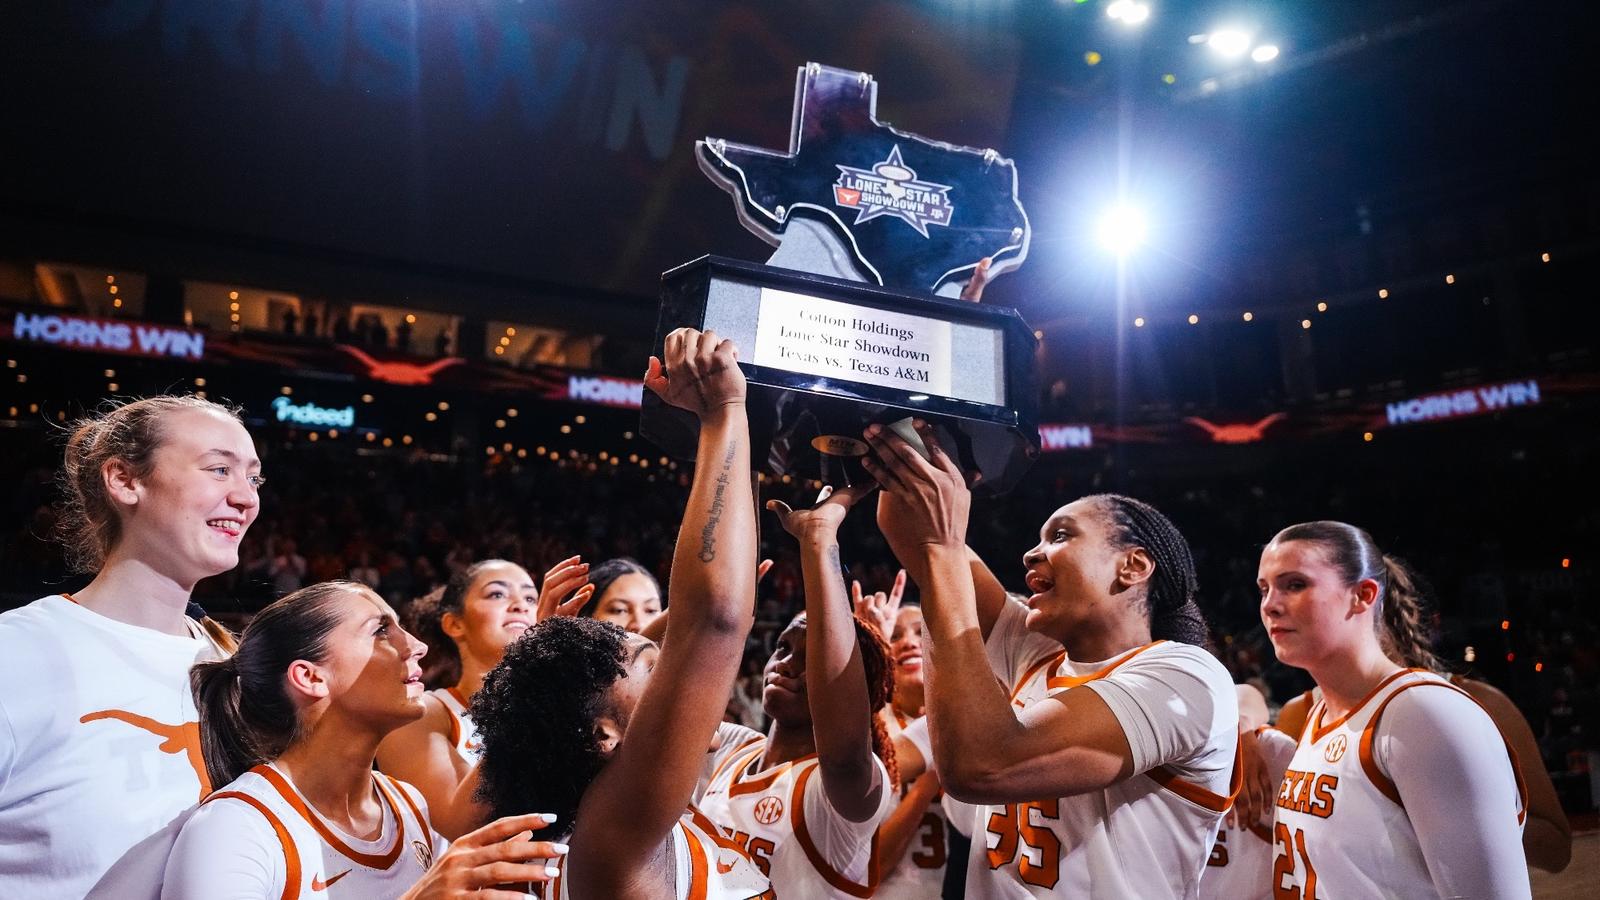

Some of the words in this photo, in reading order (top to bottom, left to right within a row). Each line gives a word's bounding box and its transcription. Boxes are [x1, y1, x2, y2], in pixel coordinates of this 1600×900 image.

[846, 177, 882, 194] LONE
[906, 189, 940, 206] STAR
[861, 192, 925, 212] SHOWDOWN
[13, 311, 133, 350] HORNS
[136, 326, 206, 360] WIN
[780, 325, 815, 342] Lone
[820, 333, 850, 349] Star
[855, 339, 930, 362] Showdown
[799, 309, 846, 328] Cotton
[852, 318, 914, 341] Holdings
[777, 345, 820, 364] Texas
[825, 356, 843, 368] vs.
[848, 357, 890, 377] Texas
[894, 366, 930, 383] A&M
[1385, 390, 1479, 425] HORNS
[1478, 379, 1541, 411] WIN
[1325, 734, 1347, 763] SEC
[754, 796, 783, 824] SEC
[1276, 769, 1339, 820] EXAS
[986, 799, 1062, 890] 35
[1273, 821, 1321, 900] 21
